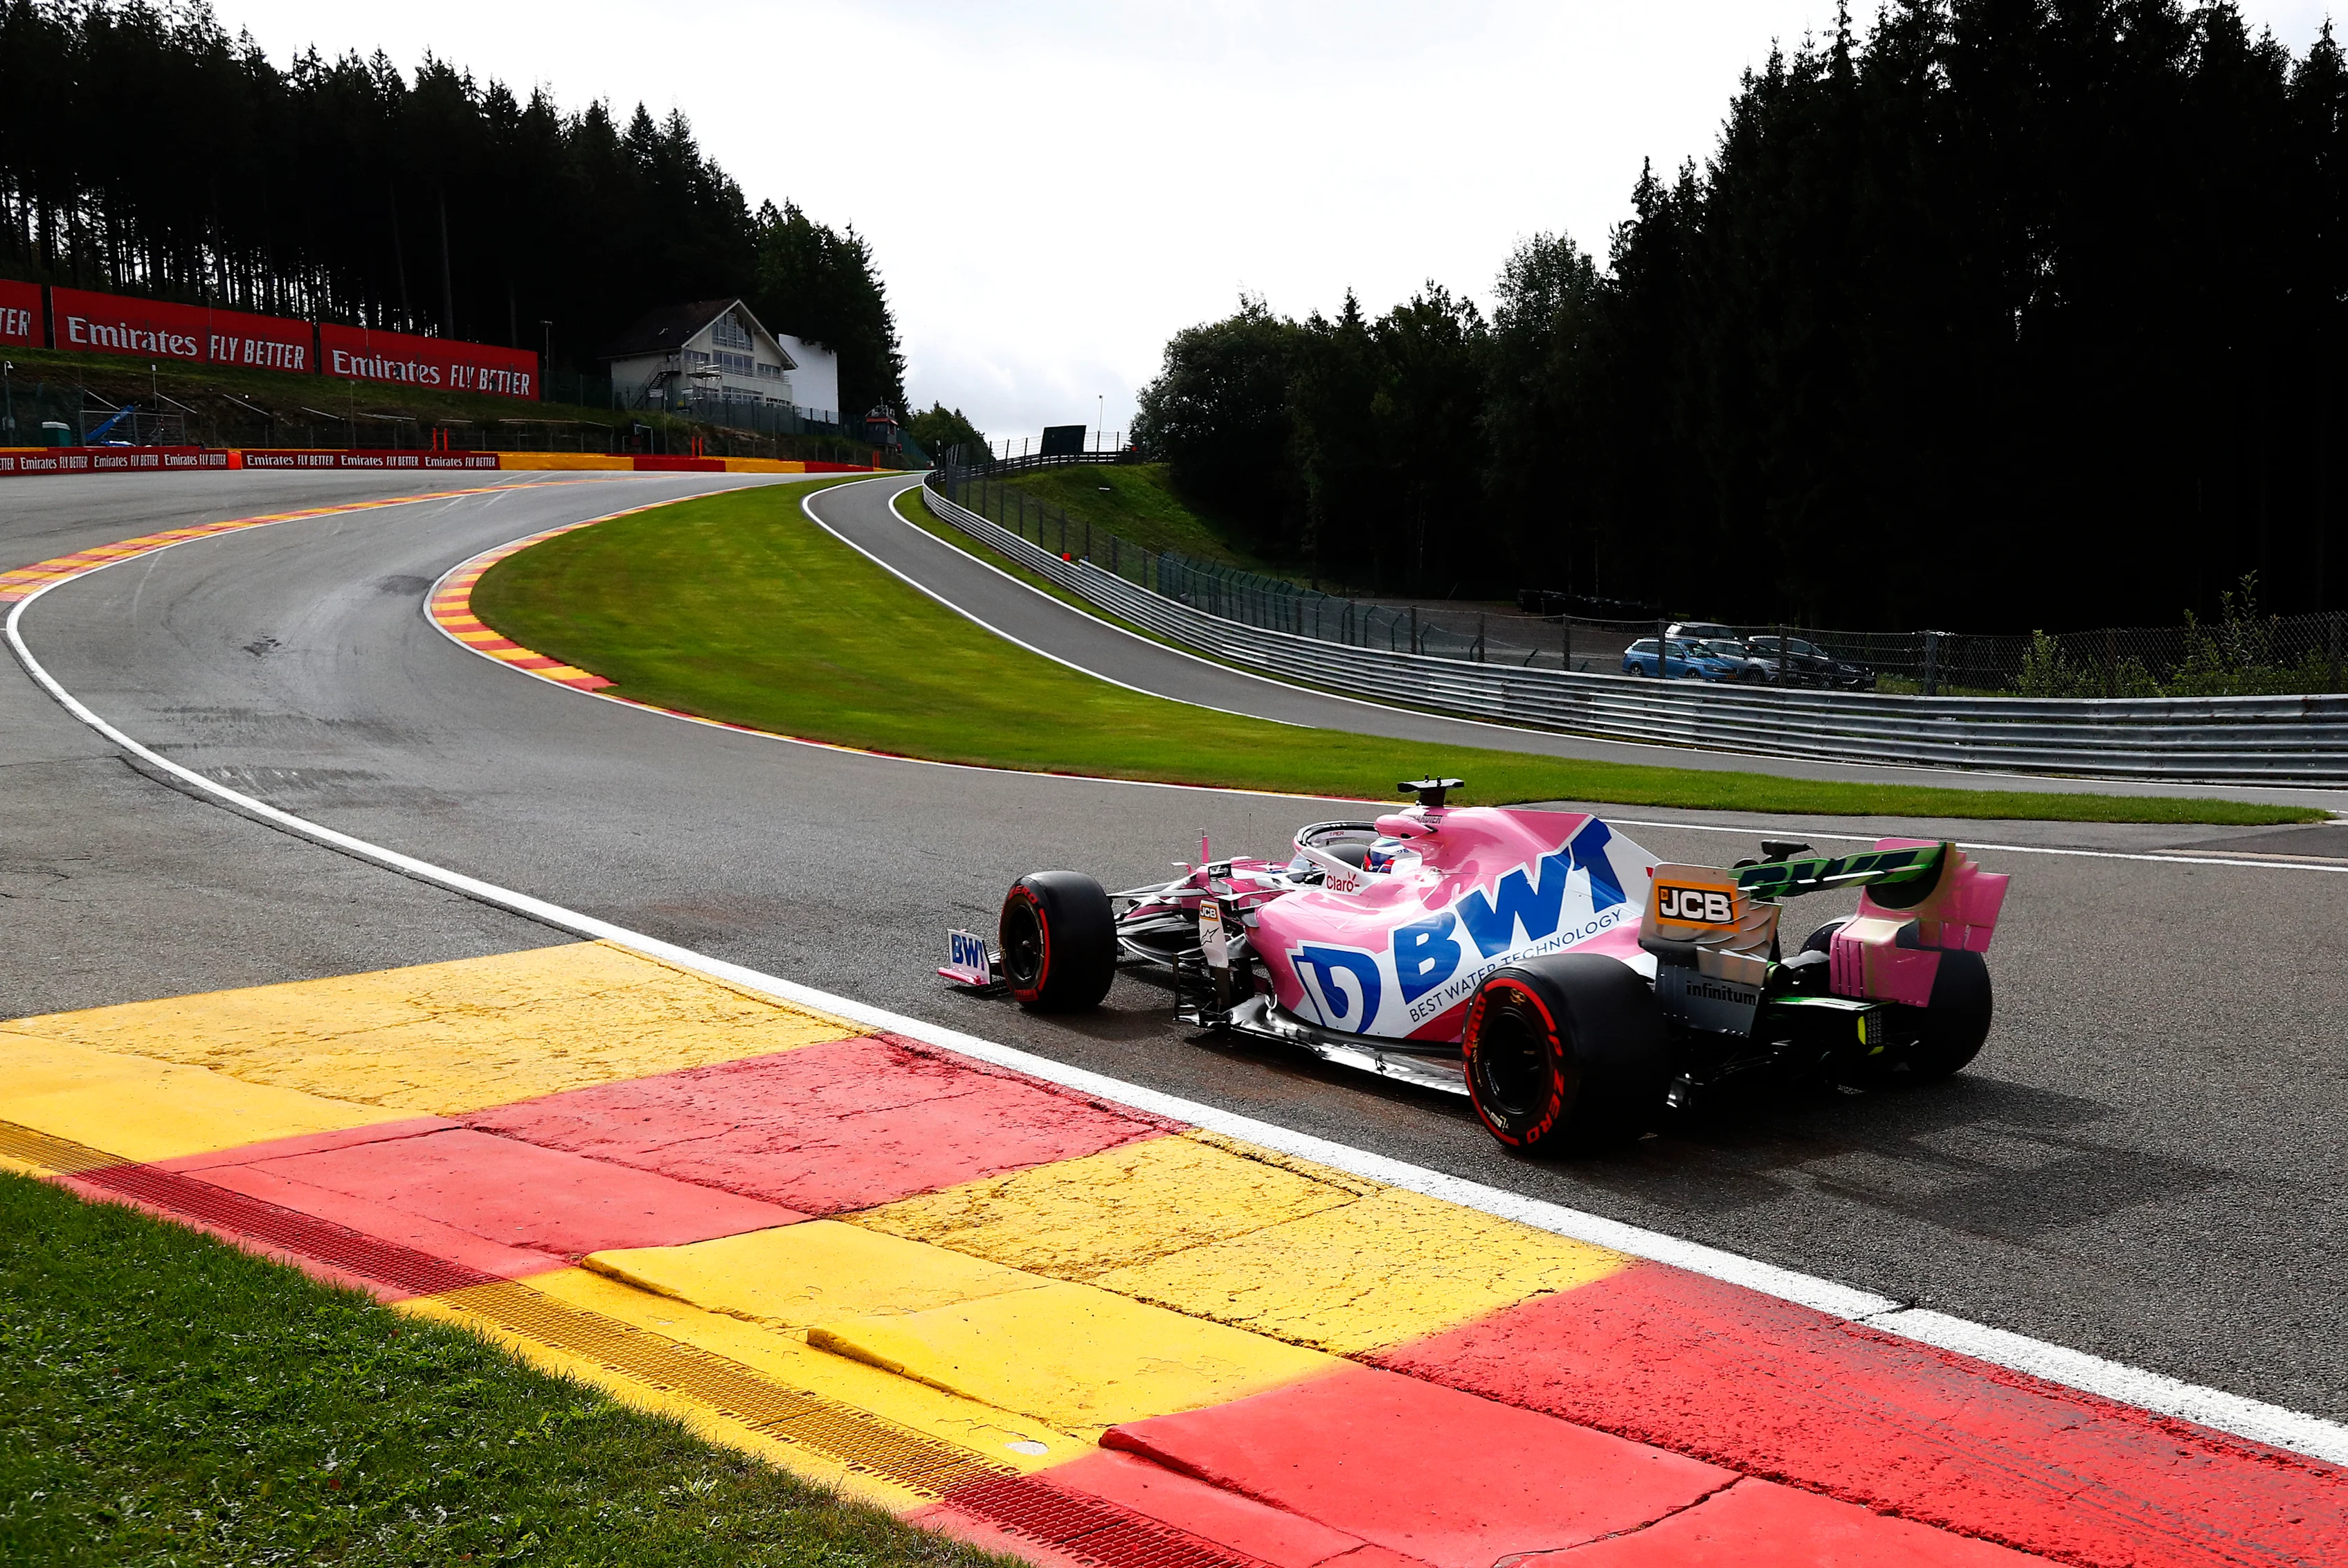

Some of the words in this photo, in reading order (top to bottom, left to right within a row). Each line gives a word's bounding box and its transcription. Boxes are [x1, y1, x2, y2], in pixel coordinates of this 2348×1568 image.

[66, 316, 198, 357] Emirates
[210, 334, 239, 361] FLY
[244, 339, 305, 370] BETTER
[332, 349, 441, 385] Emirates
[450, 364, 475, 389] FLY
[478, 368, 530, 396] BETTER
[19, 456, 57, 470] Emirates
[60, 456, 68, 469] FLY
[69, 456, 89, 468] BETTER
[94, 455, 128, 468] Emirates
[130, 454, 139, 467] FLY
[140, 454, 159, 467] BETTER
[164, 453, 198, 466] Emirates
[199, 453, 208, 465] FLY
[209, 453, 226, 465] BETTER
[246, 454, 294, 466] Emirates
[298, 454, 308, 465] FLY
[309, 455, 334, 466] BETTER
[341, 455, 383, 466] Emirates
[386, 456, 397, 467] FLY
[398, 456, 419, 467] BETTER
[424, 456, 462, 467] Emirates
[464, 456, 476, 467] FLY
[476, 456, 496, 467] BETTER
[1326, 874, 1355, 892] Claro
[1200, 906, 1217, 919] JCB
[1393, 817, 1627, 1005] BWT
[1660, 890, 1732, 921] JCB
[1409, 992, 1442, 1022] BEST
[1444, 963, 1496, 1000] WATER
[1500, 909, 1623, 964] TECHNOLOGY
[1686, 980, 1757, 1007] infinitum
[1548, 1034, 1564, 1057] P
[1526, 1067, 1565, 1144] ZERO
